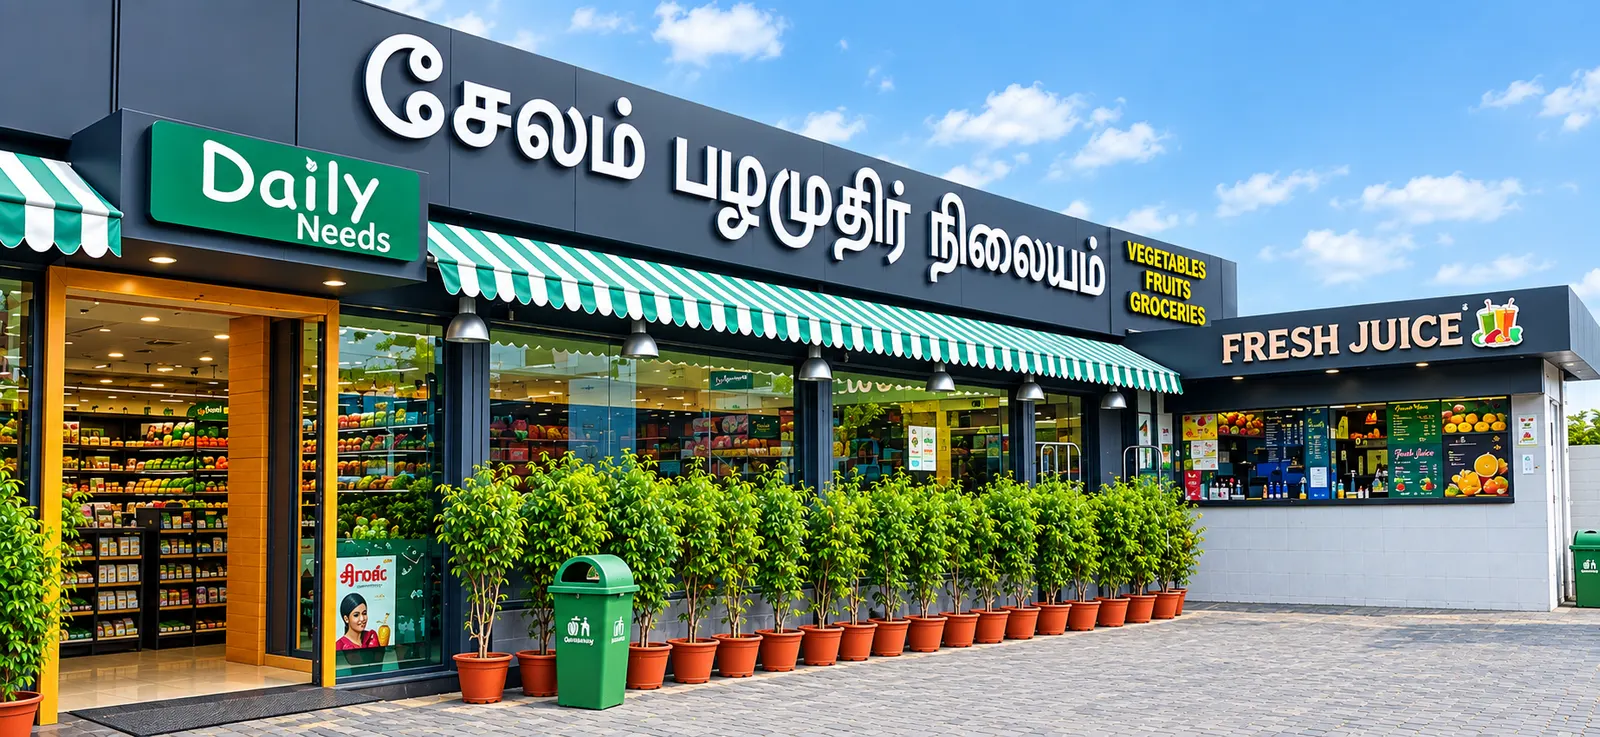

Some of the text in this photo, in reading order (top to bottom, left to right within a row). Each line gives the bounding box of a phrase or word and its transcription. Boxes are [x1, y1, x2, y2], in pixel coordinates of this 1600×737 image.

[202, 139, 379, 223] Daily
[364, 33, 1106, 297] சேலம் பழமுதிர் நிலையம்
[297, 212, 391, 253] Needs
[1127, 240, 1207, 280] VEGETABLES
[1145, 270, 1192, 300] FRUITS
[1130, 291, 1206, 326] GROCERIES
[1221, 312, 1464, 364] FRESH JUICE
